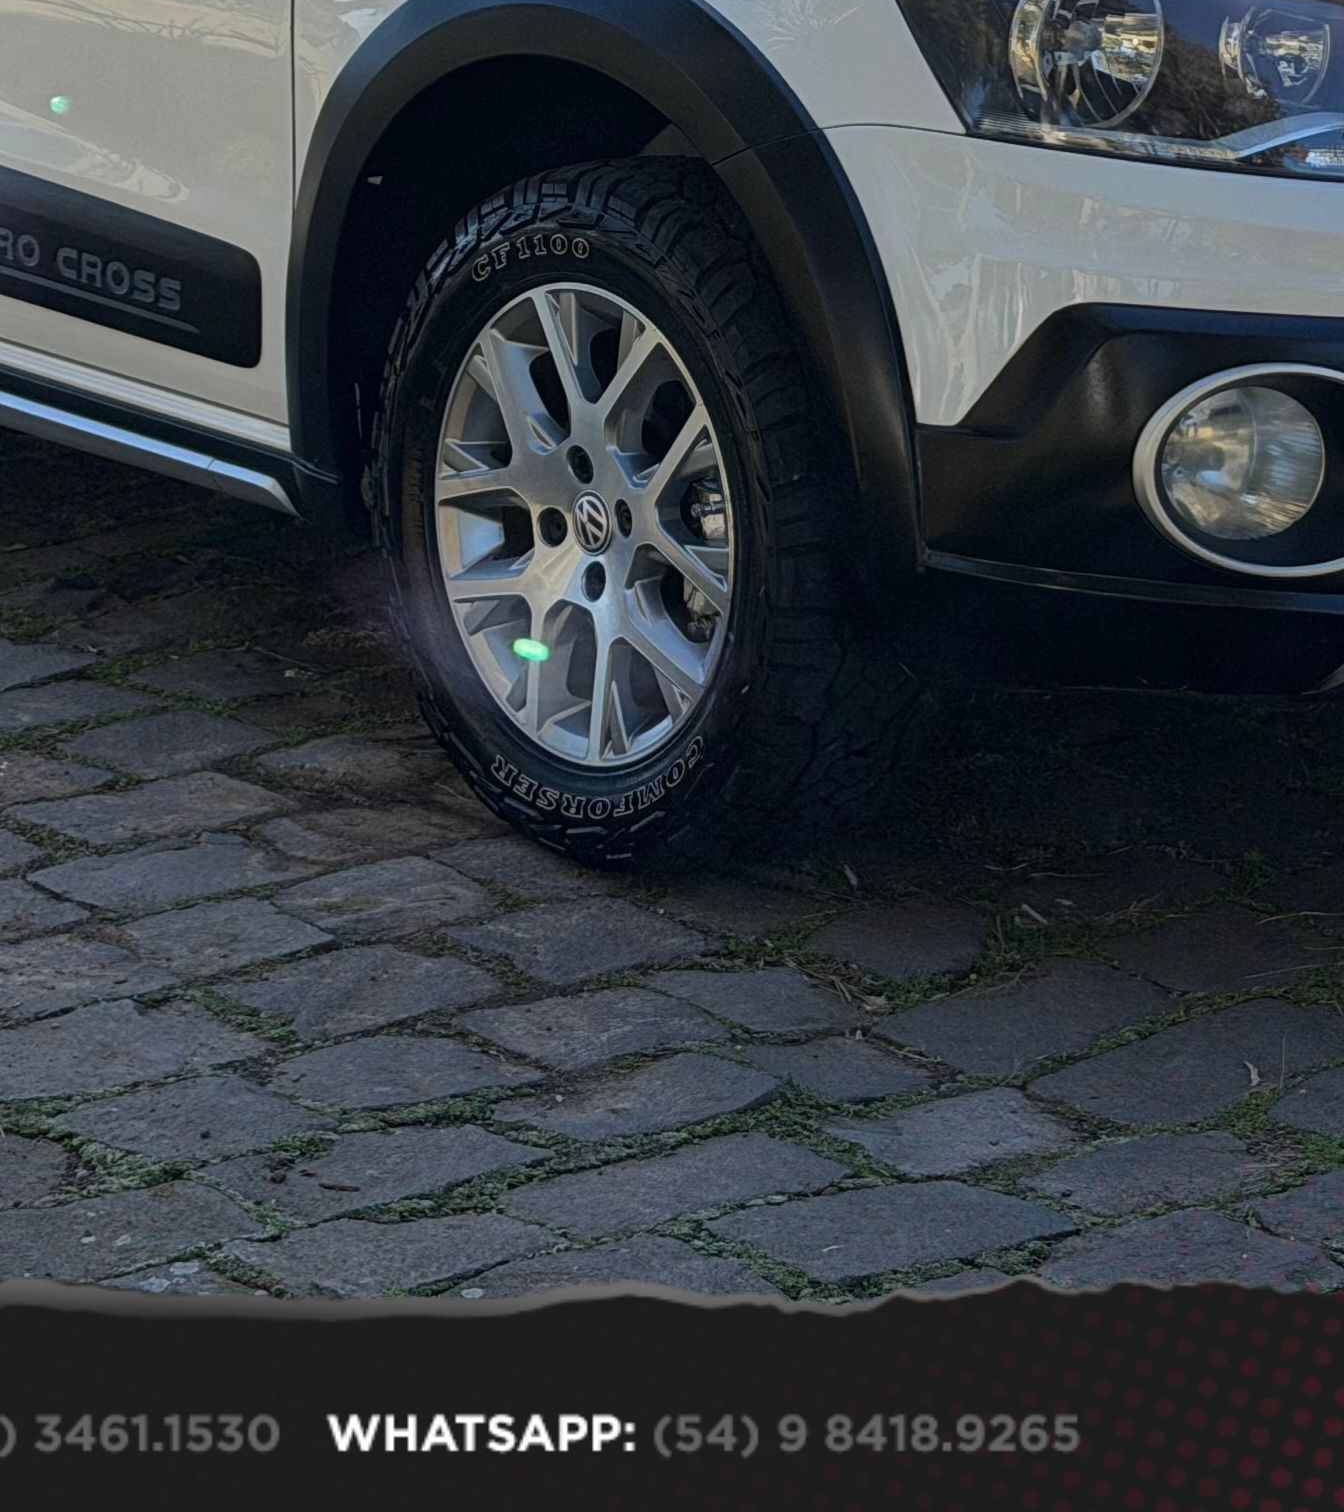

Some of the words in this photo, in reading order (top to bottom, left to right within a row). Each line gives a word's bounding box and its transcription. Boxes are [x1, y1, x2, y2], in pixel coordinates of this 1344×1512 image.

[56, 246, 182, 311] CROSS
[470, 233, 590, 282] CF1100
[490, 735, 705, 820] COMFORSER
